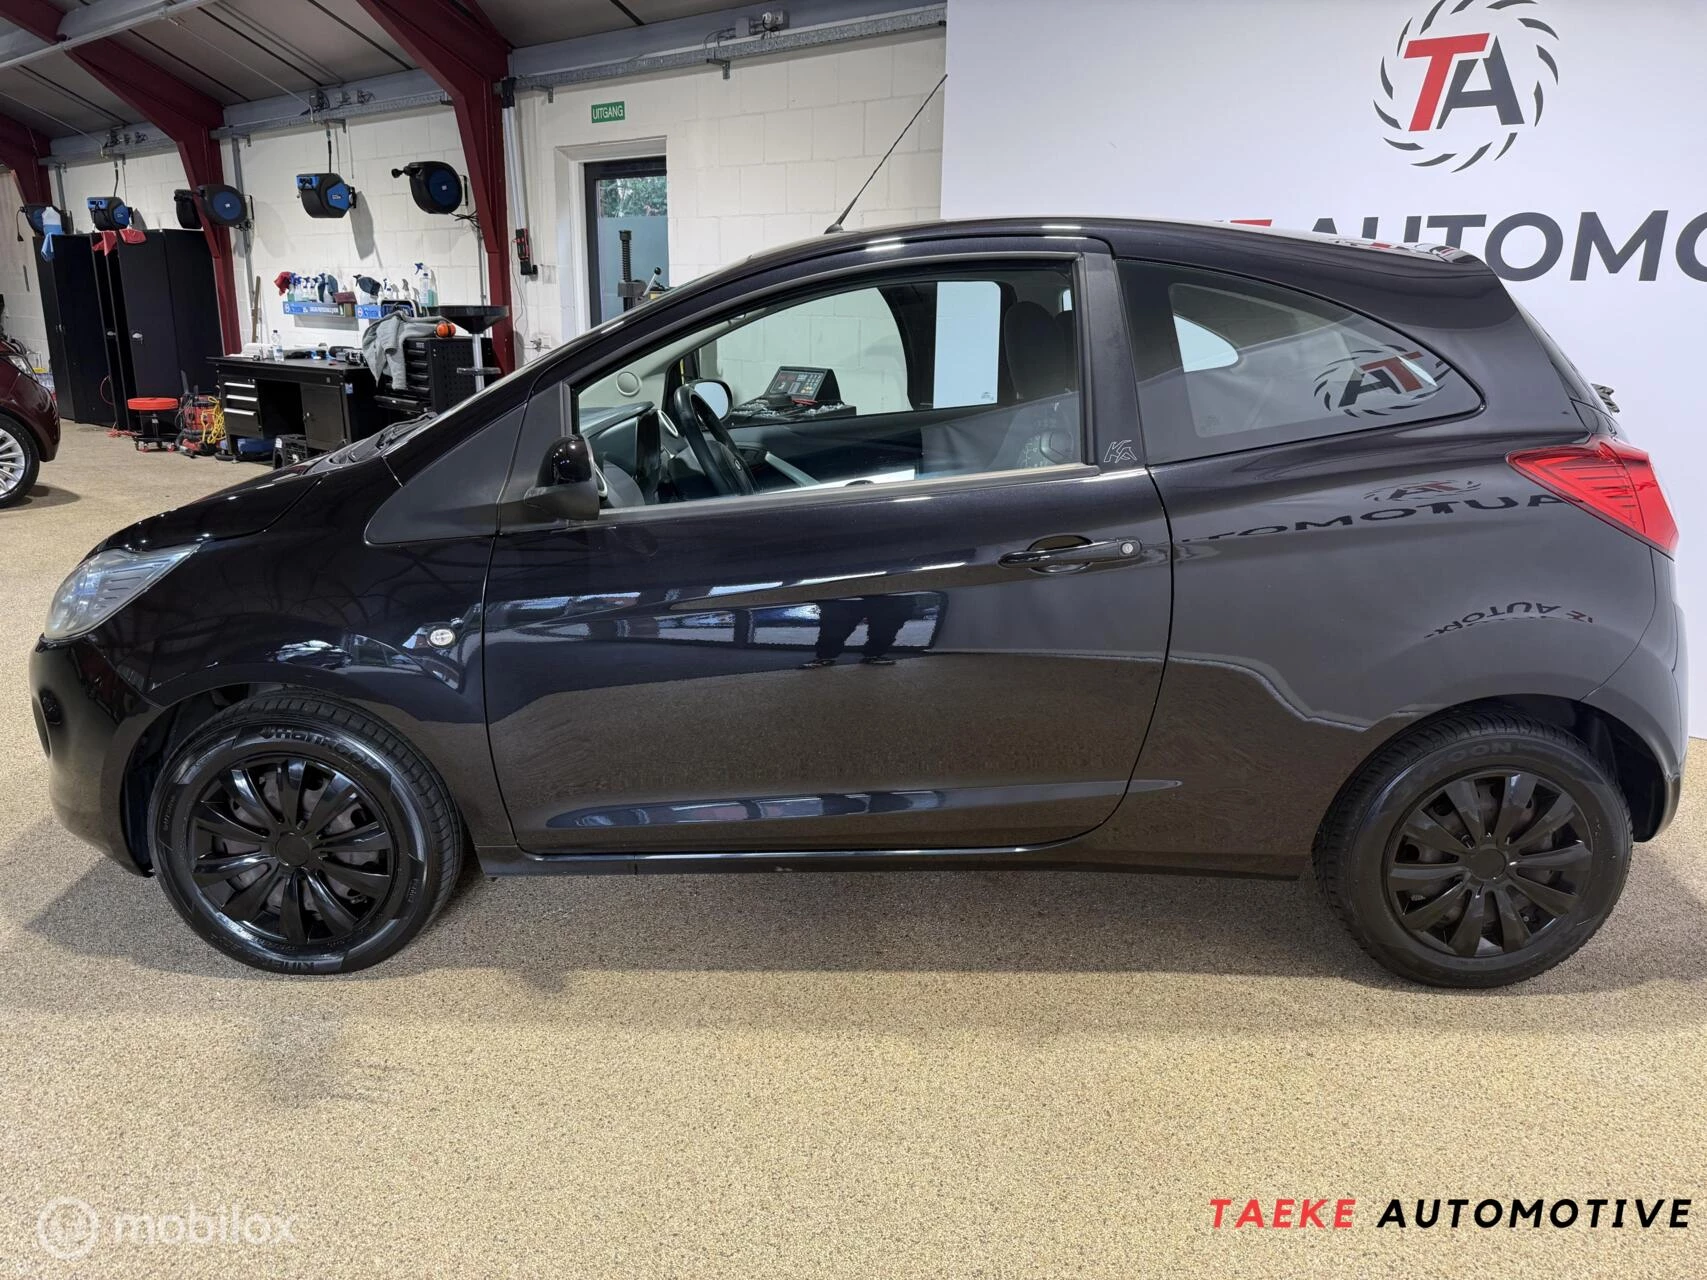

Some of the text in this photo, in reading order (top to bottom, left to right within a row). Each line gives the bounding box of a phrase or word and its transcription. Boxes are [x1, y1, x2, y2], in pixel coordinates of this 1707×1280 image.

[1403, 32, 1525, 132] TA
[592, 104, 624, 120] UITGANG
[1312, 209, 1707, 282] TOM
[1103, 439, 1138, 464] KA
